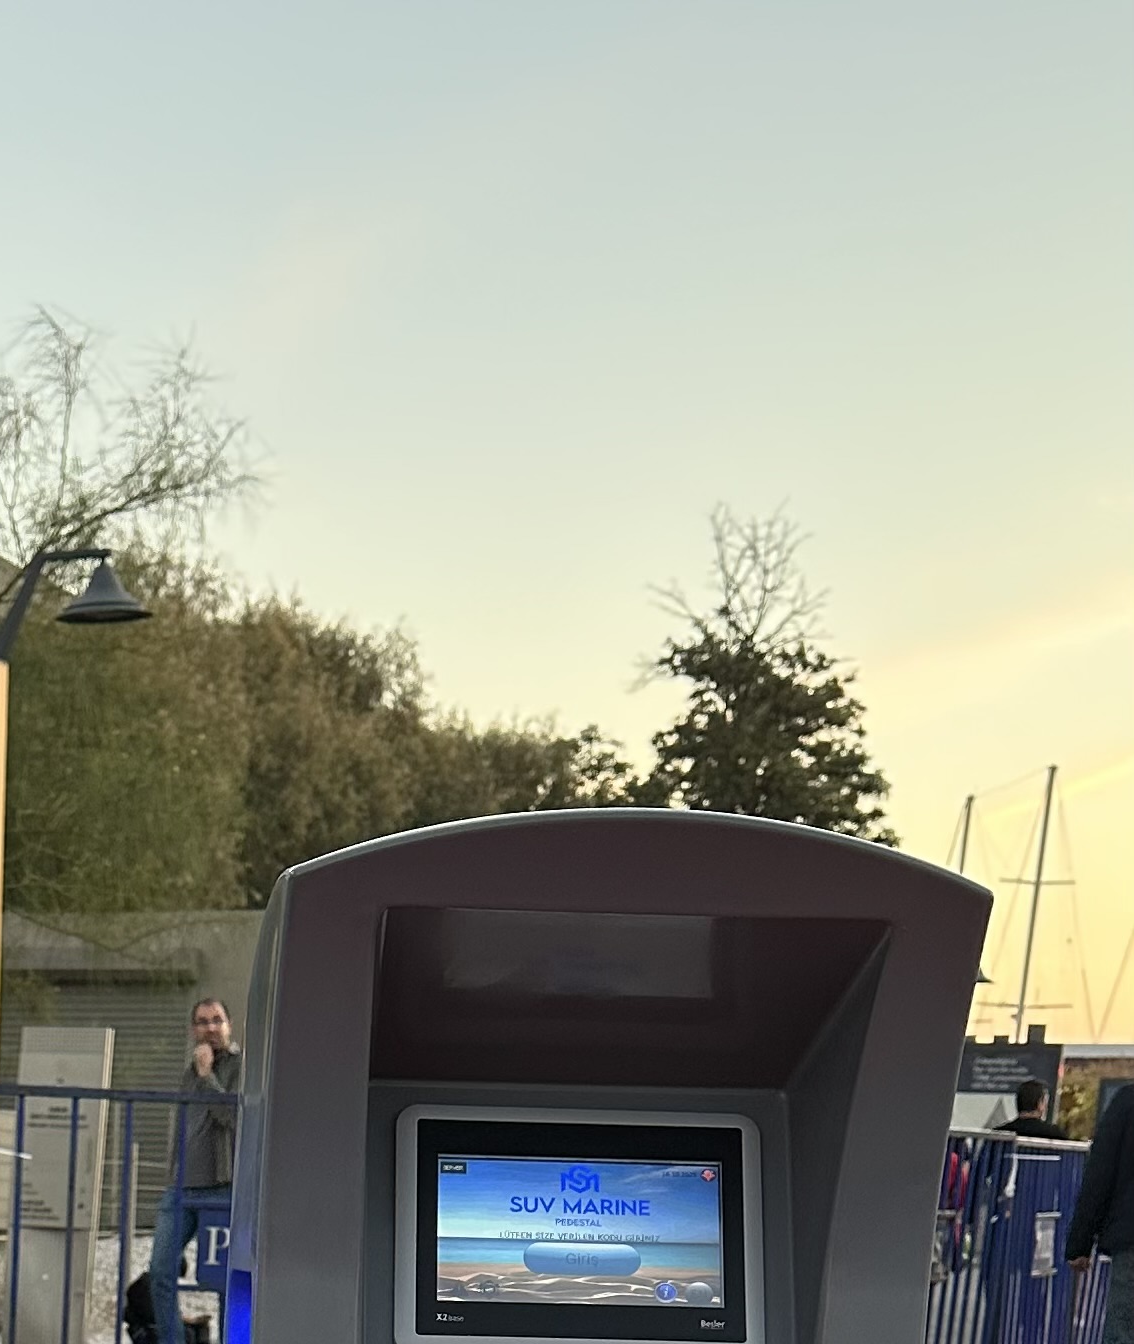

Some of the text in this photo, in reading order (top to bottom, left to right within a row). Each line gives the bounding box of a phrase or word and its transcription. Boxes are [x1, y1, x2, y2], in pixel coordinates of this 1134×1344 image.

[509, 1196, 651, 1216] SUV MARINE
[555, 1218, 602, 1227] PEDESTAL
[566, 1252, 599, 1266] Giriş
[436, 1313, 448, 1322] X2
